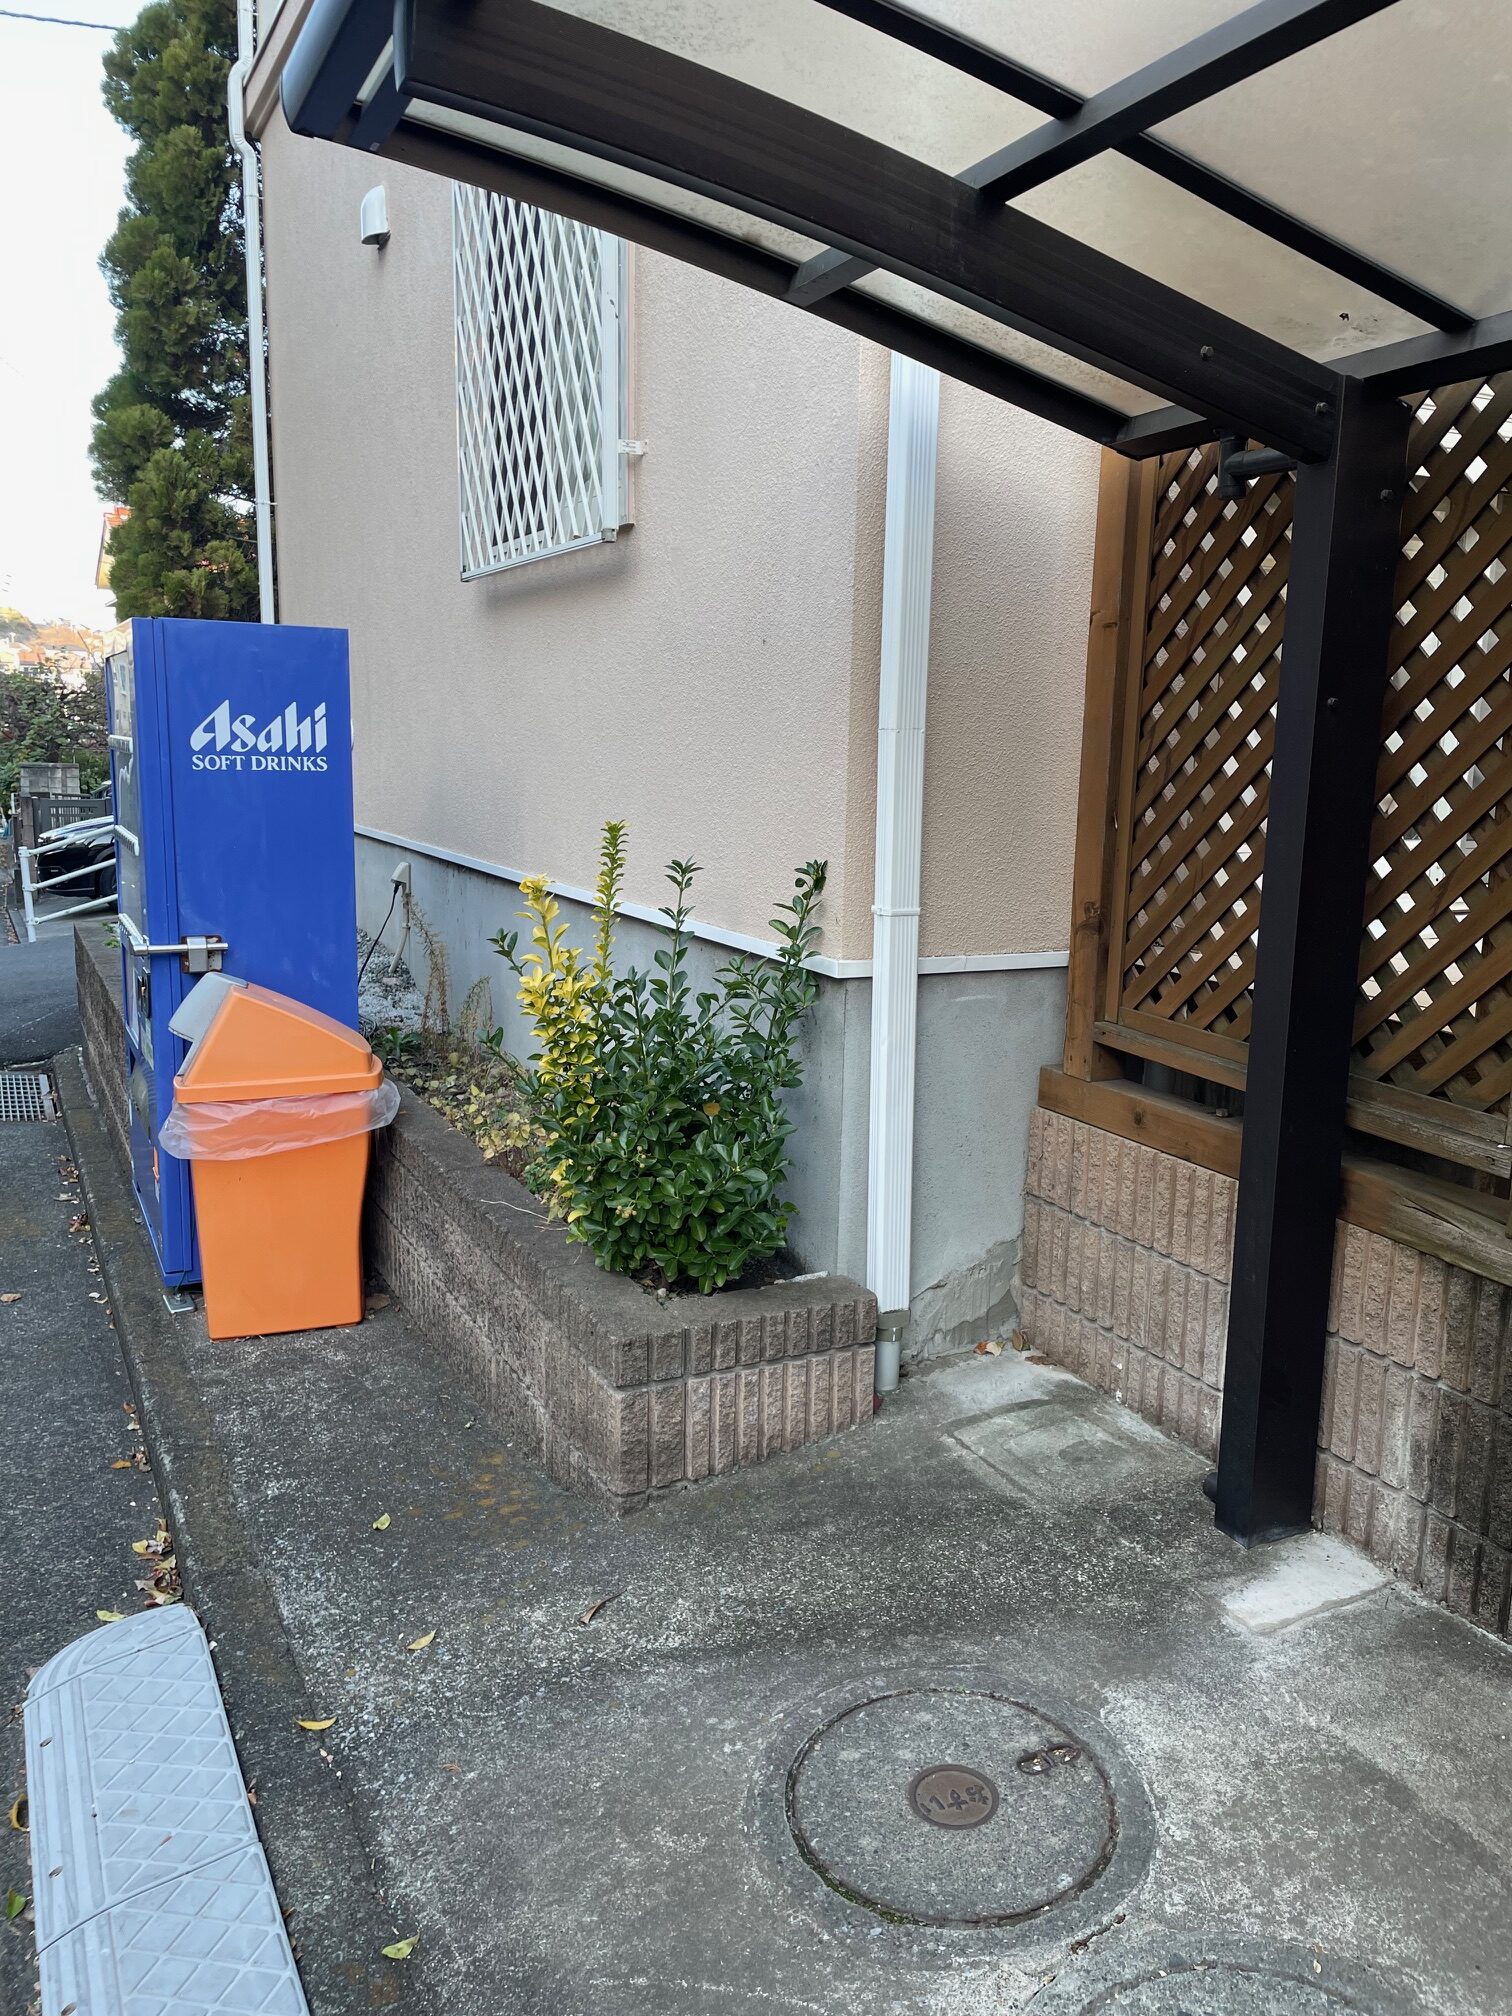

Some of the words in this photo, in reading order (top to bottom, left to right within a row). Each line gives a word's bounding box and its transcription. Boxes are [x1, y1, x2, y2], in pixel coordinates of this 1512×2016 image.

[190, 699, 327, 753] Asahi
[192, 754, 246, 771] SOFT
[251, 755, 328, 772] DRINKS
[919, 1784, 990, 1814] おすい
